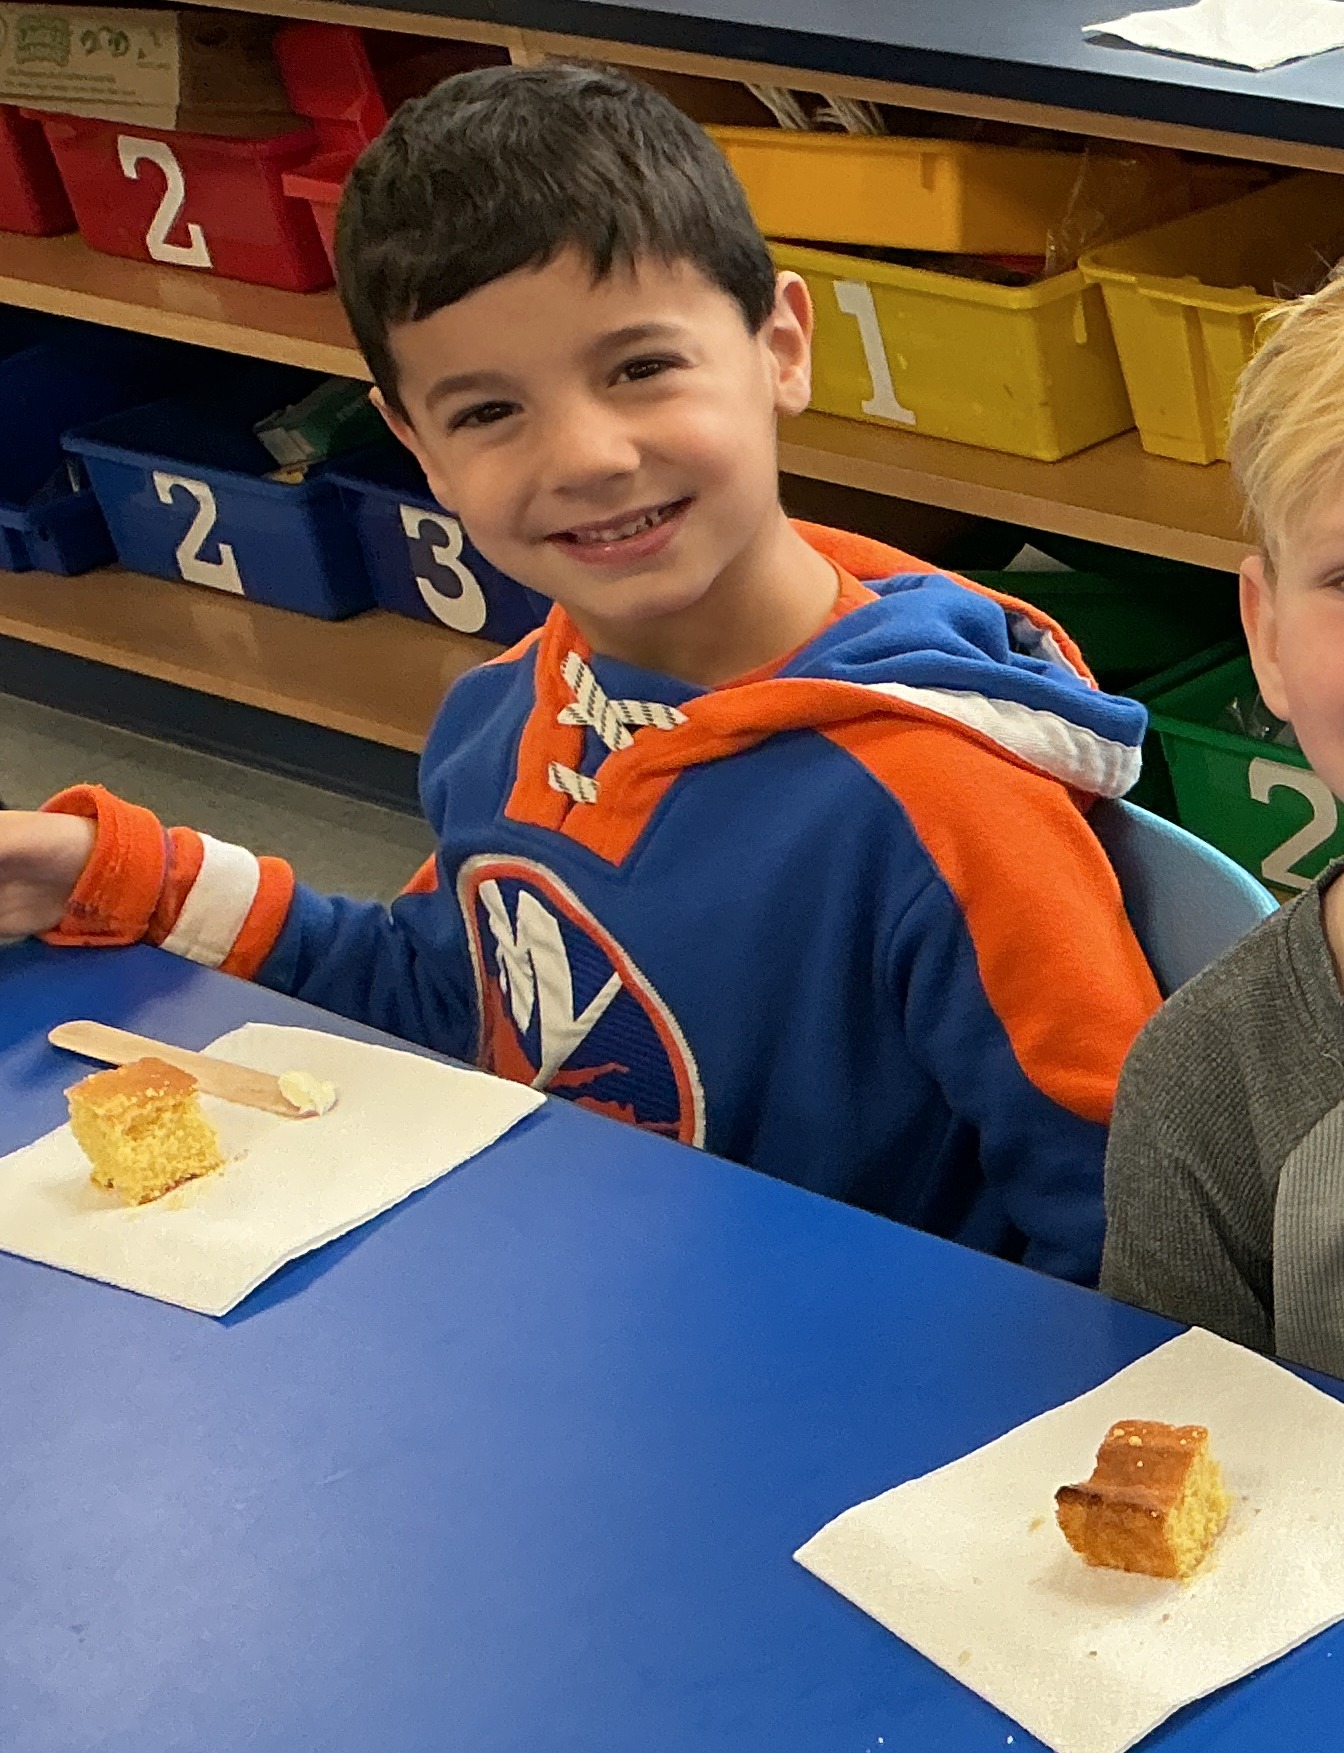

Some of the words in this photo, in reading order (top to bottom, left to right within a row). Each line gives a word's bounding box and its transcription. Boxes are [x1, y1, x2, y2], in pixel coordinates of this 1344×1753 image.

[117, 135, 214, 268] 2
[833, 279, 916, 426] 1
[153, 471, 245, 595] 2
[400, 503, 487, 634] 3
[1247, 756, 1338, 890] 2
